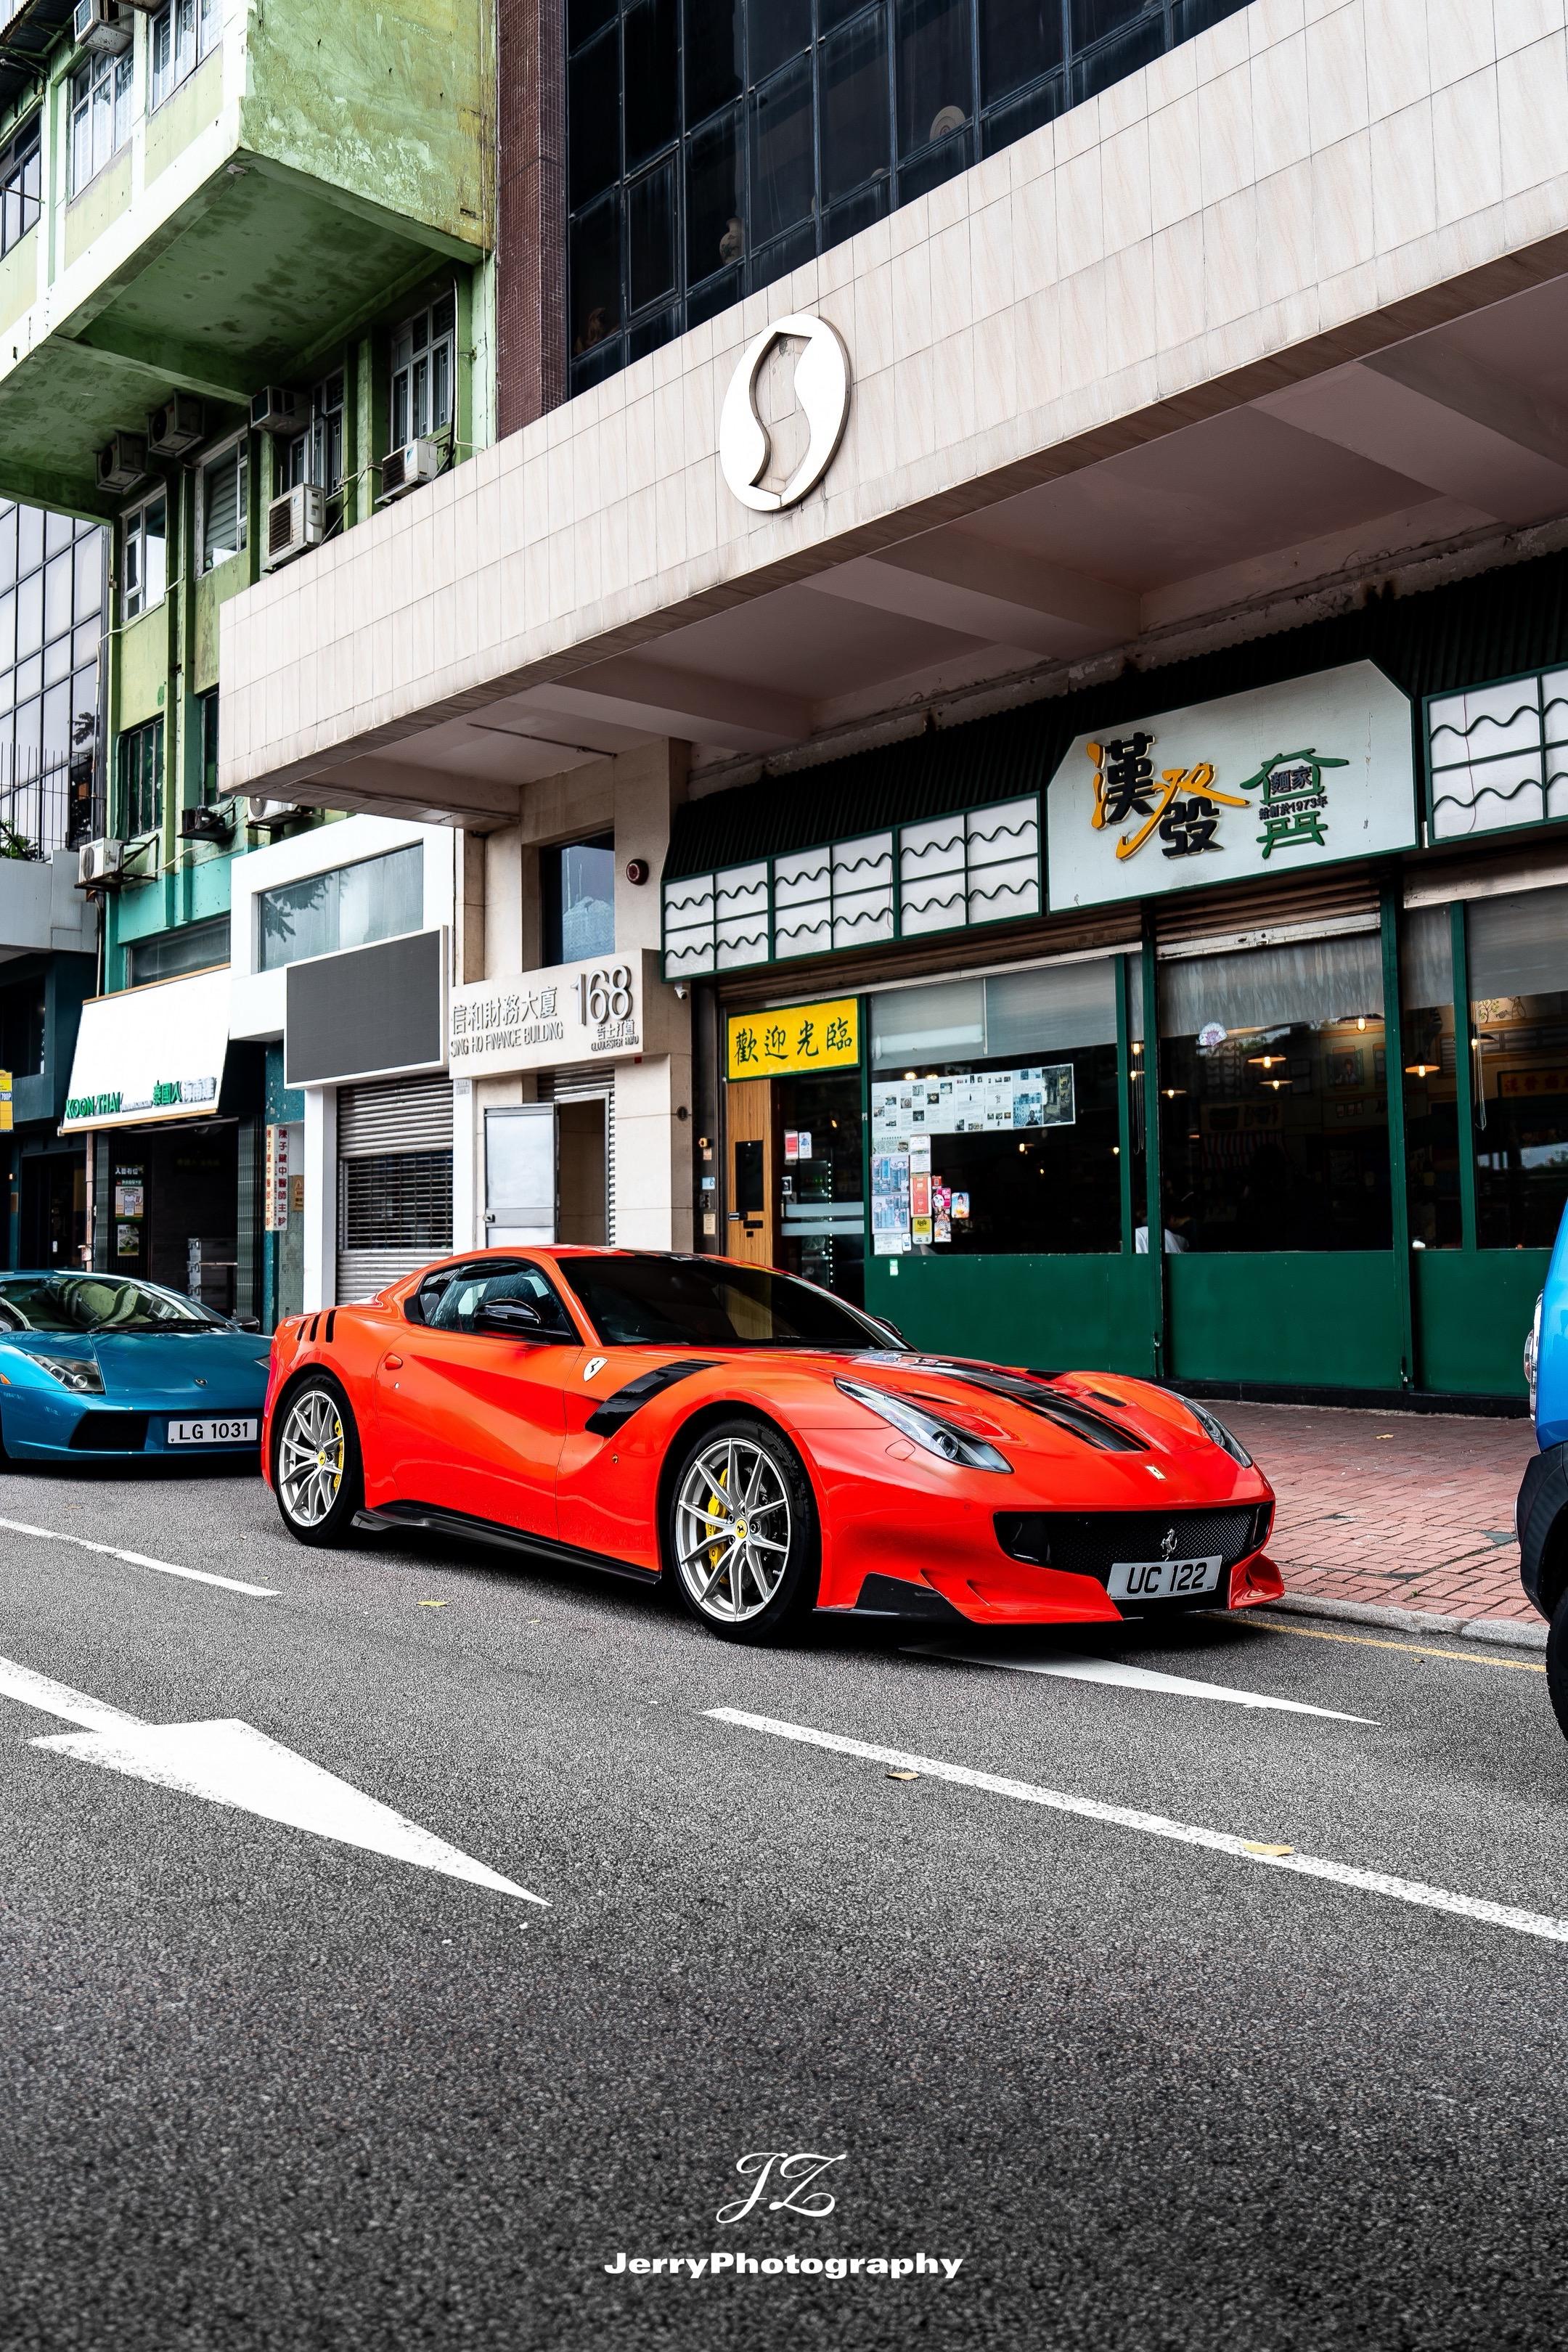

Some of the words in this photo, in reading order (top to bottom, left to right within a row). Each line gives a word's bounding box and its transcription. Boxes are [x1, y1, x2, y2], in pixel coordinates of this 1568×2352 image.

[450, 986, 558, 1035] 信和財務大廈
[571, 965, 633, 1026] 168
[450, 1038, 468, 1058] SING
[472, 1035, 483, 1053] HO
[486, 1027, 521, 1051] FINANCE
[524, 1021, 563, 1043] BUILDING
[734, 1016, 854, 1065] 歡迎光臨
[65, 1095, 95, 1119] KOON
[96, 1091, 121, 1114] THAI
[179, 1424, 203, 1440] LG
[211, 1421, 248, 1439] 1031
[1126, 1566, 1162, 1595] UC
[1169, 1561, 1208, 1592] 122
